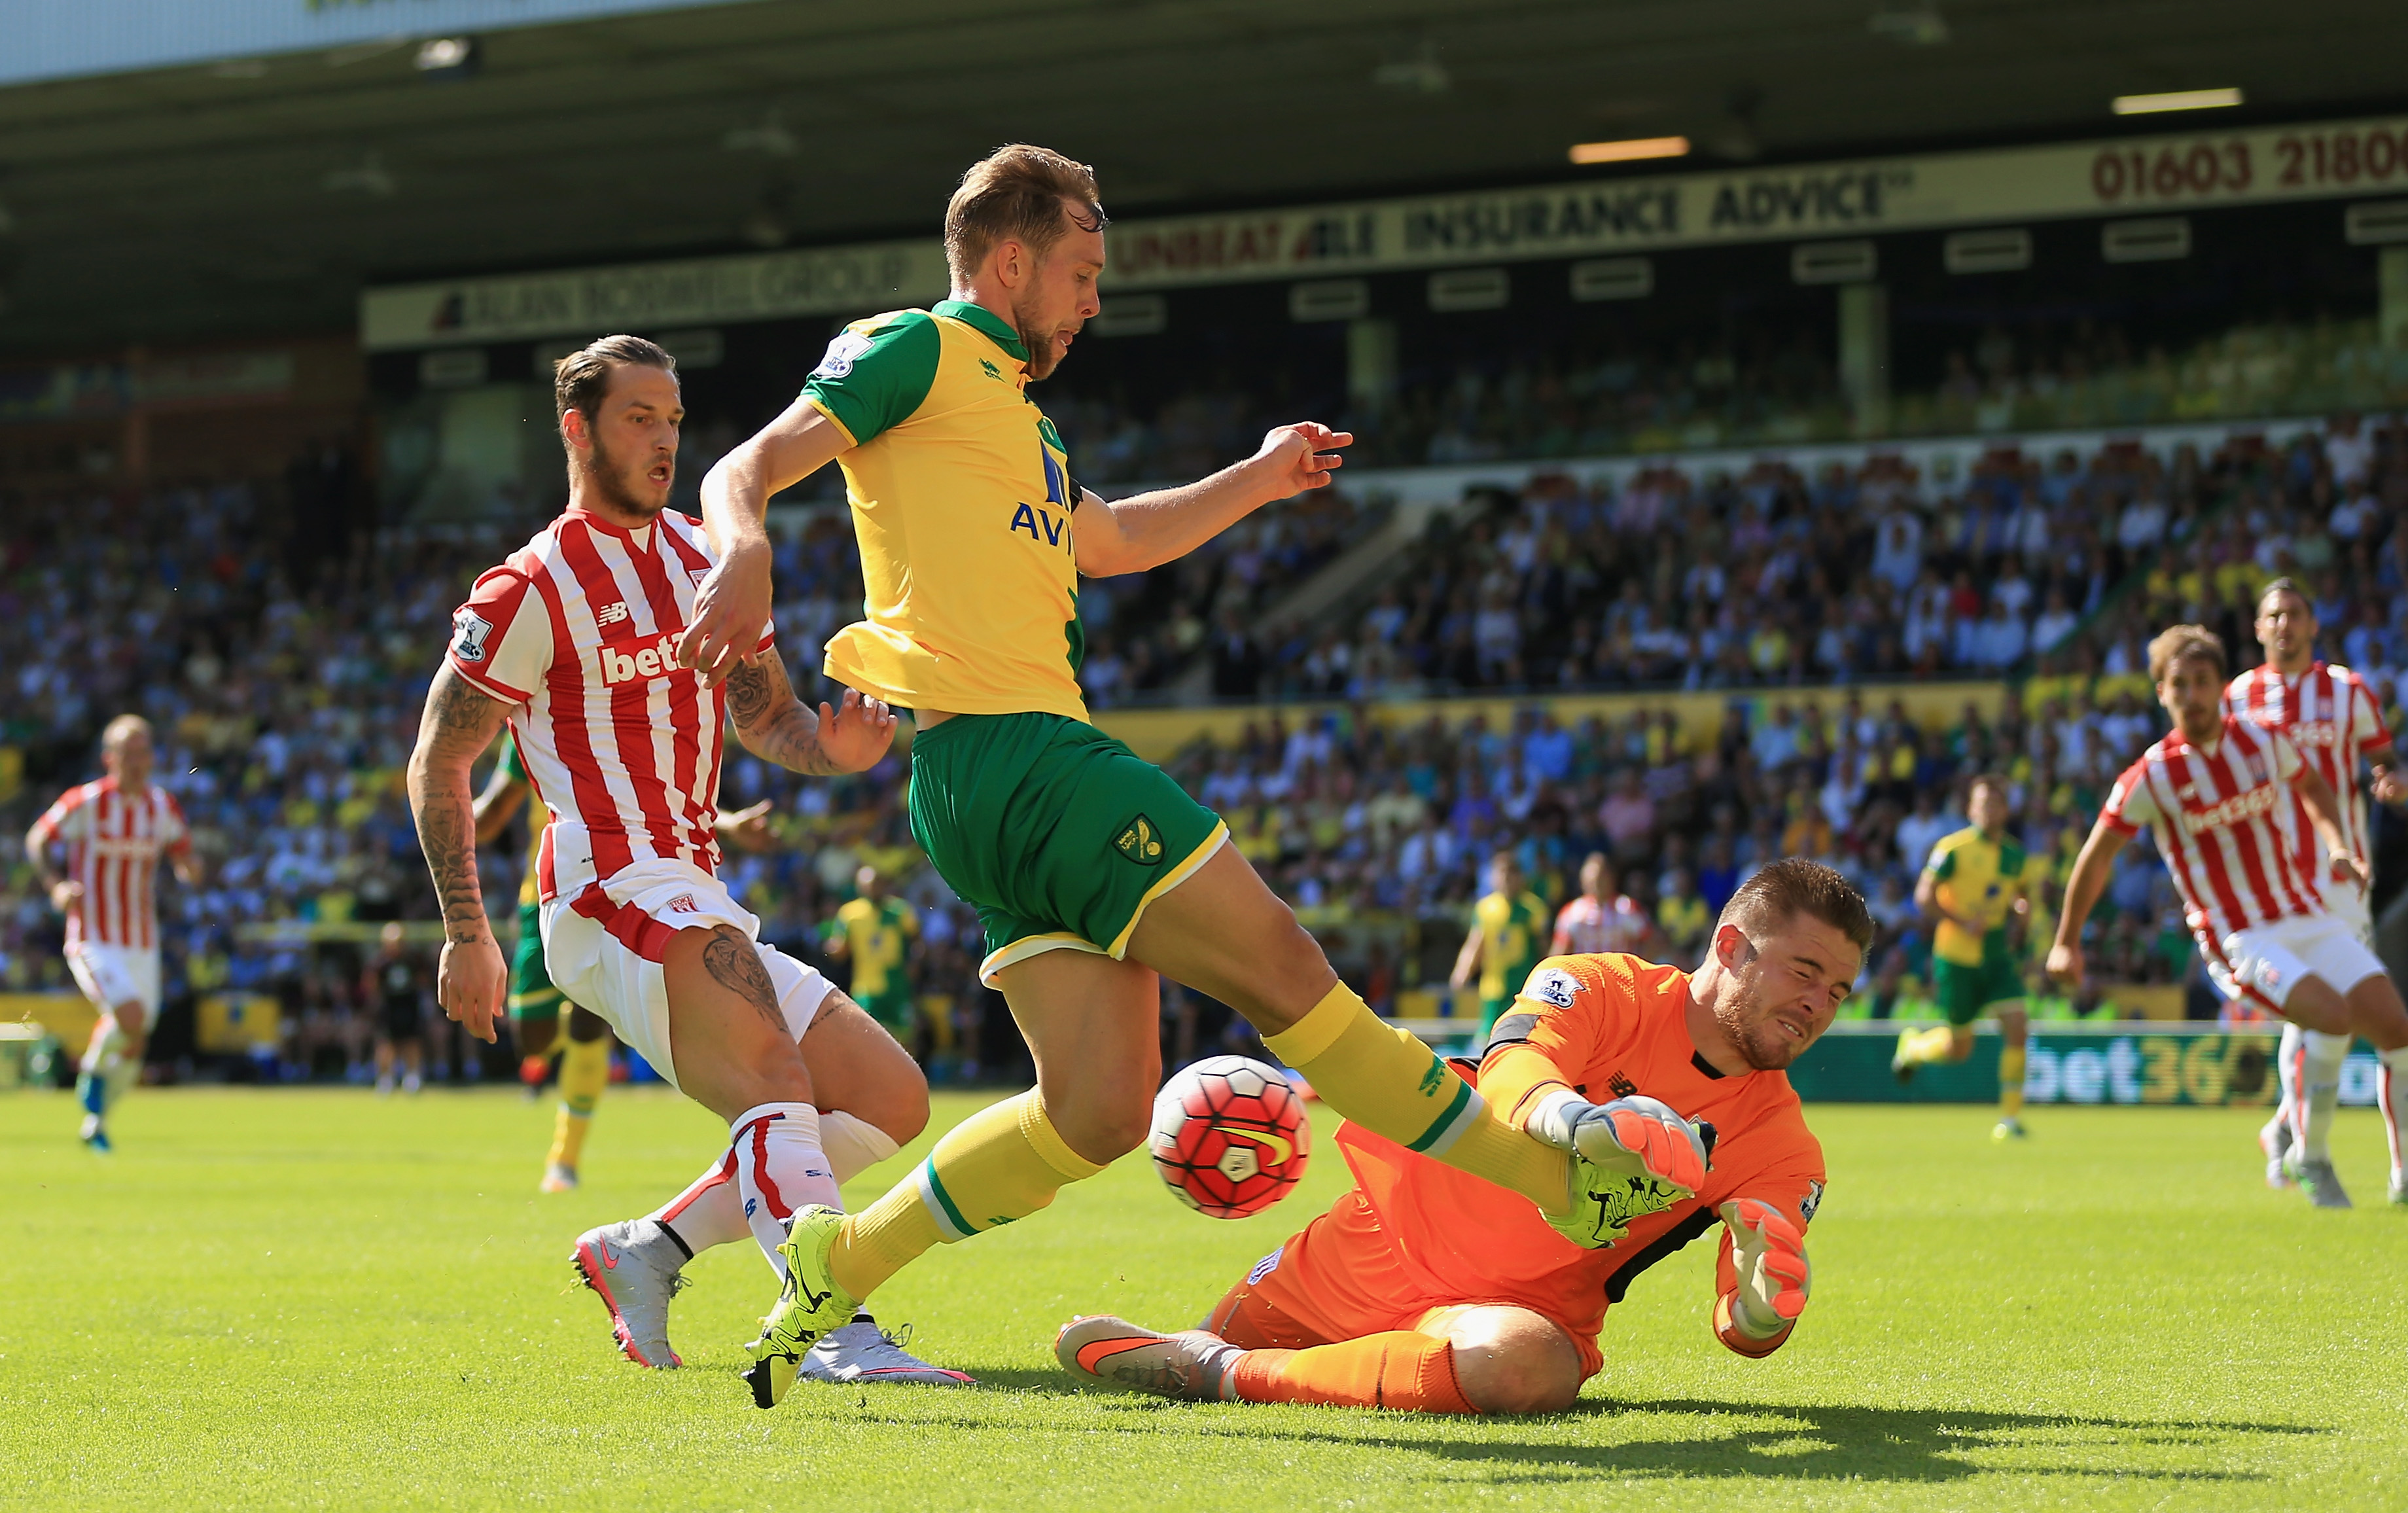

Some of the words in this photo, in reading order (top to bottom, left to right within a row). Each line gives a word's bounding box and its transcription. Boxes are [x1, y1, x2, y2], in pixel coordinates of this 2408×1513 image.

[2093, 140, 2252, 200] 01603
[1404, 187, 1682, 250] INSURANCE
[2023, 1033, 2278, 1105] bet365
